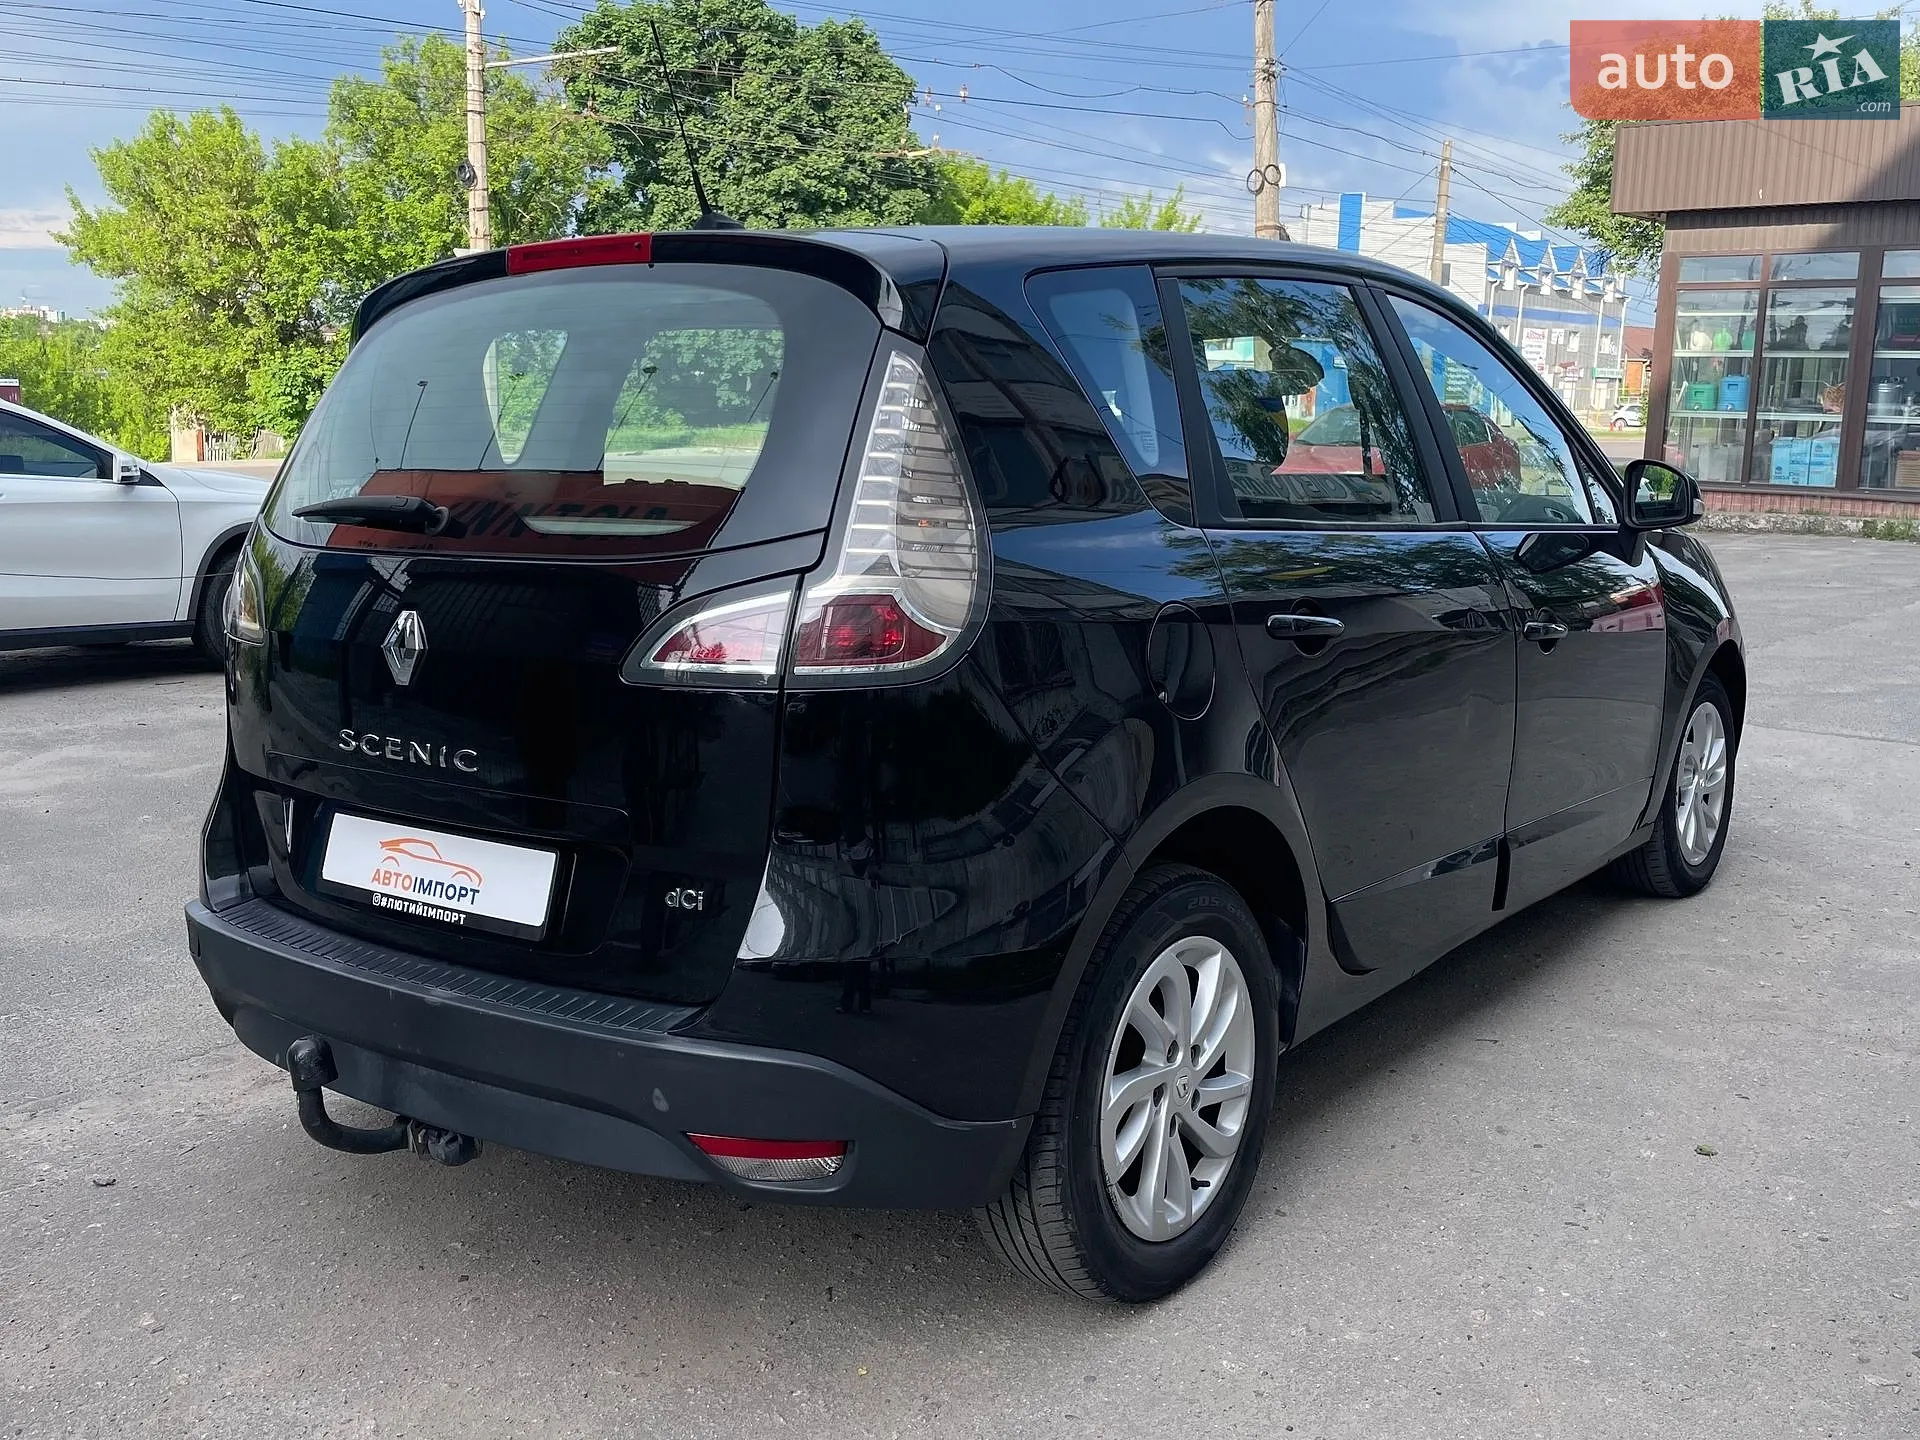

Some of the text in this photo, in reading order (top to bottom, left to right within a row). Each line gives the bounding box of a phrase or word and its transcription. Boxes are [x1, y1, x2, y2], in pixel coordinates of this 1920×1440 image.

[338, 728, 479, 772] SCENIC
[371, 868, 481, 905] АВТОІМПОРТ
[665, 887, 704, 911] dCi
